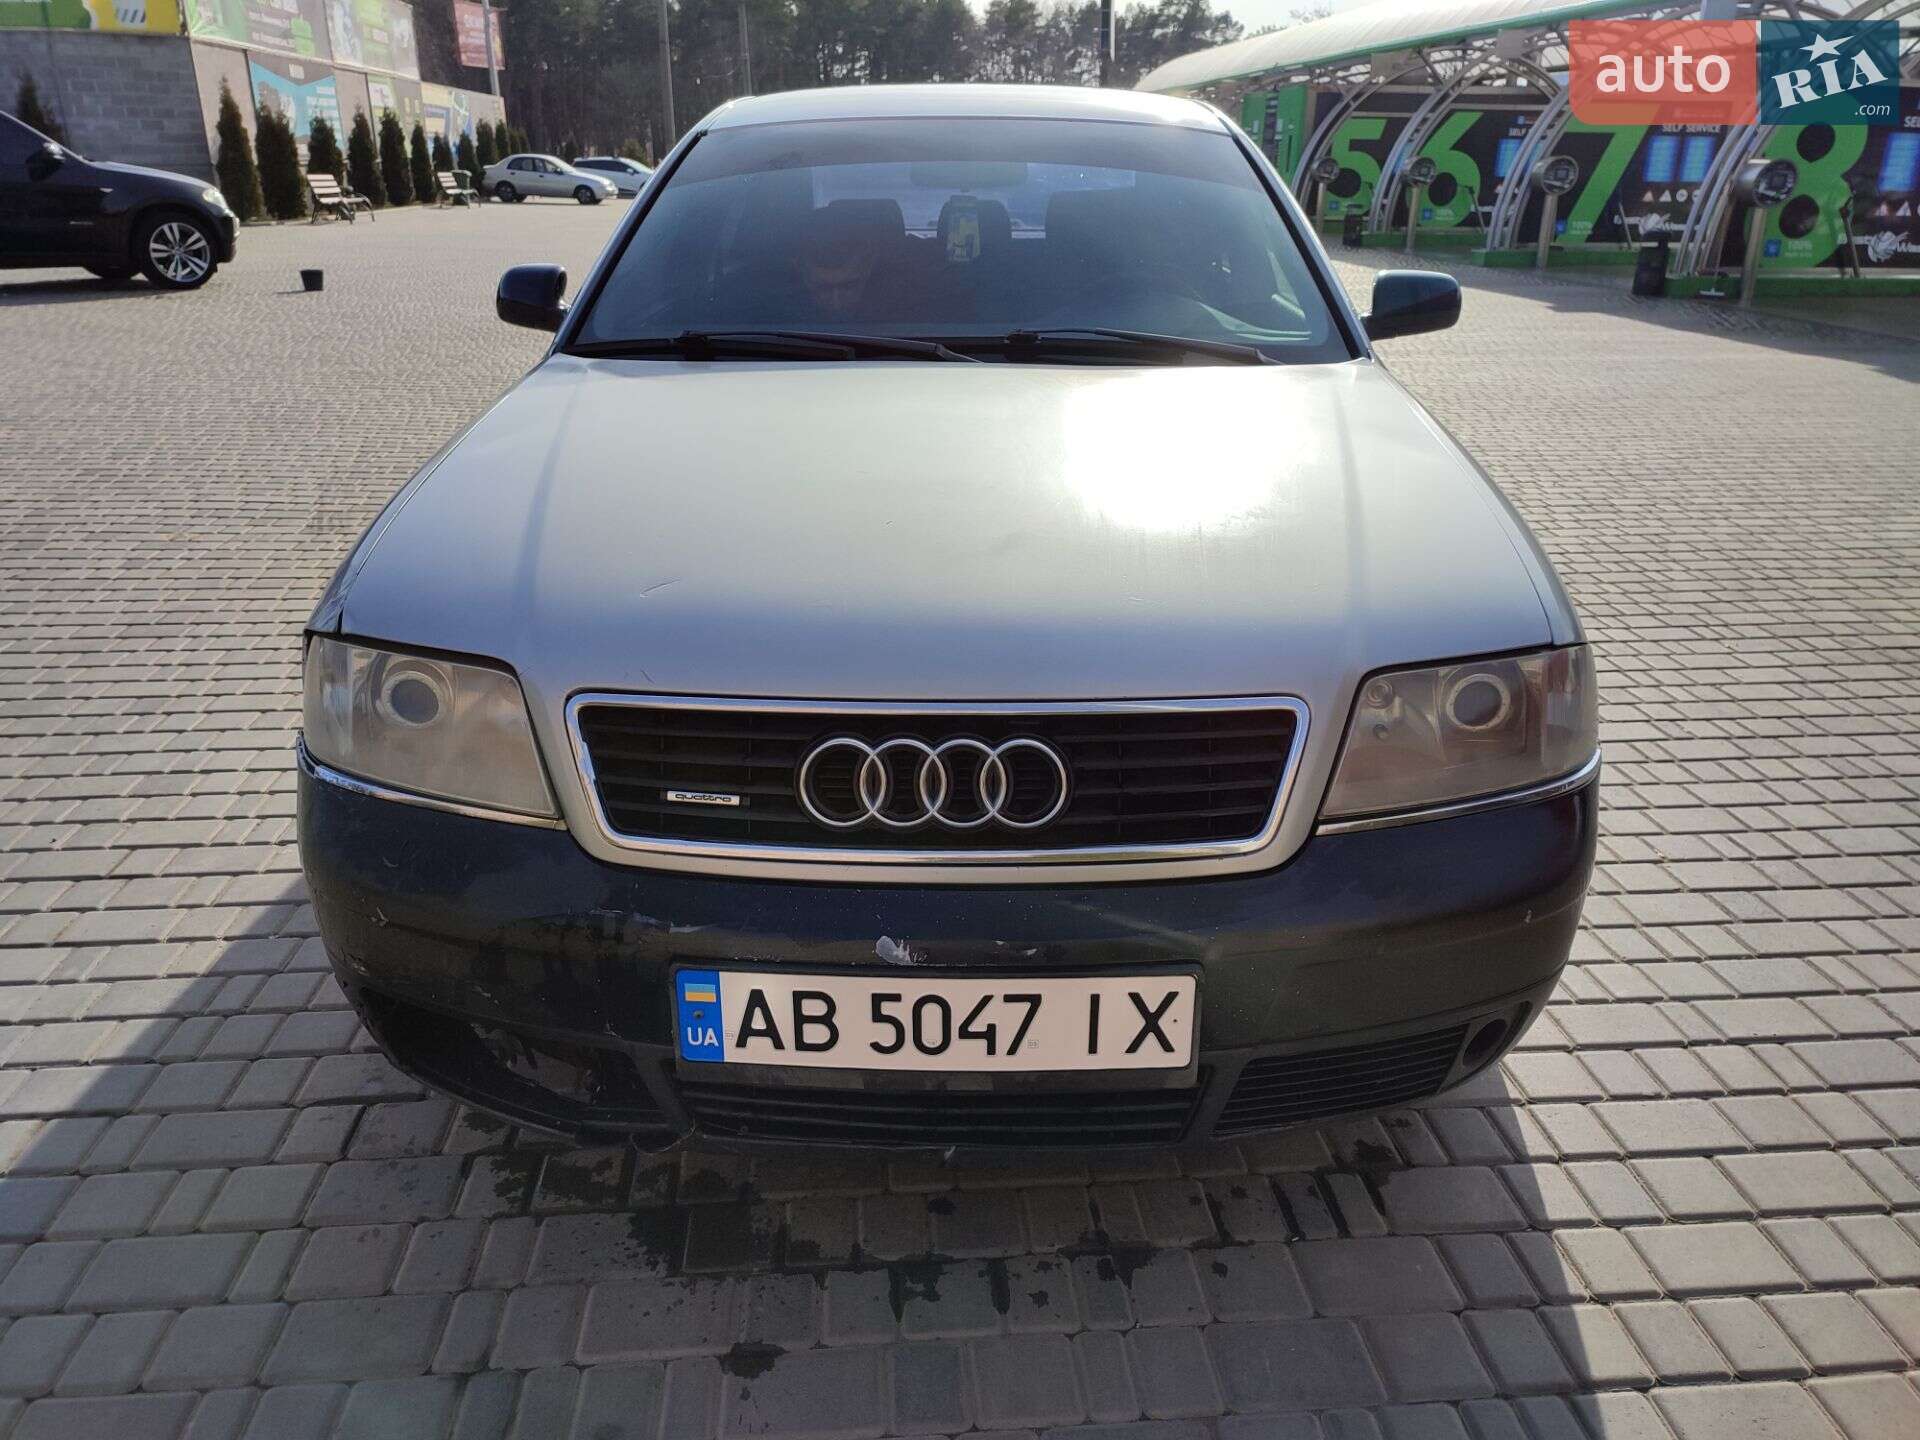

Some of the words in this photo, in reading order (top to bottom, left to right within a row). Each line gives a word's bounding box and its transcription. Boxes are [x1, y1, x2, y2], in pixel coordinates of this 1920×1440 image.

[1322, 118, 1383, 220] 5
[1406, 112, 1484, 227] 6
[1555, 103, 1661, 242] 7
[1744, 91, 1869, 268] 8
[675, 793, 732, 802] quattro
[687, 1027, 719, 1047] UA
[735, 989, 840, 1052] AB
[869, 992, 1042, 1056] 5047
